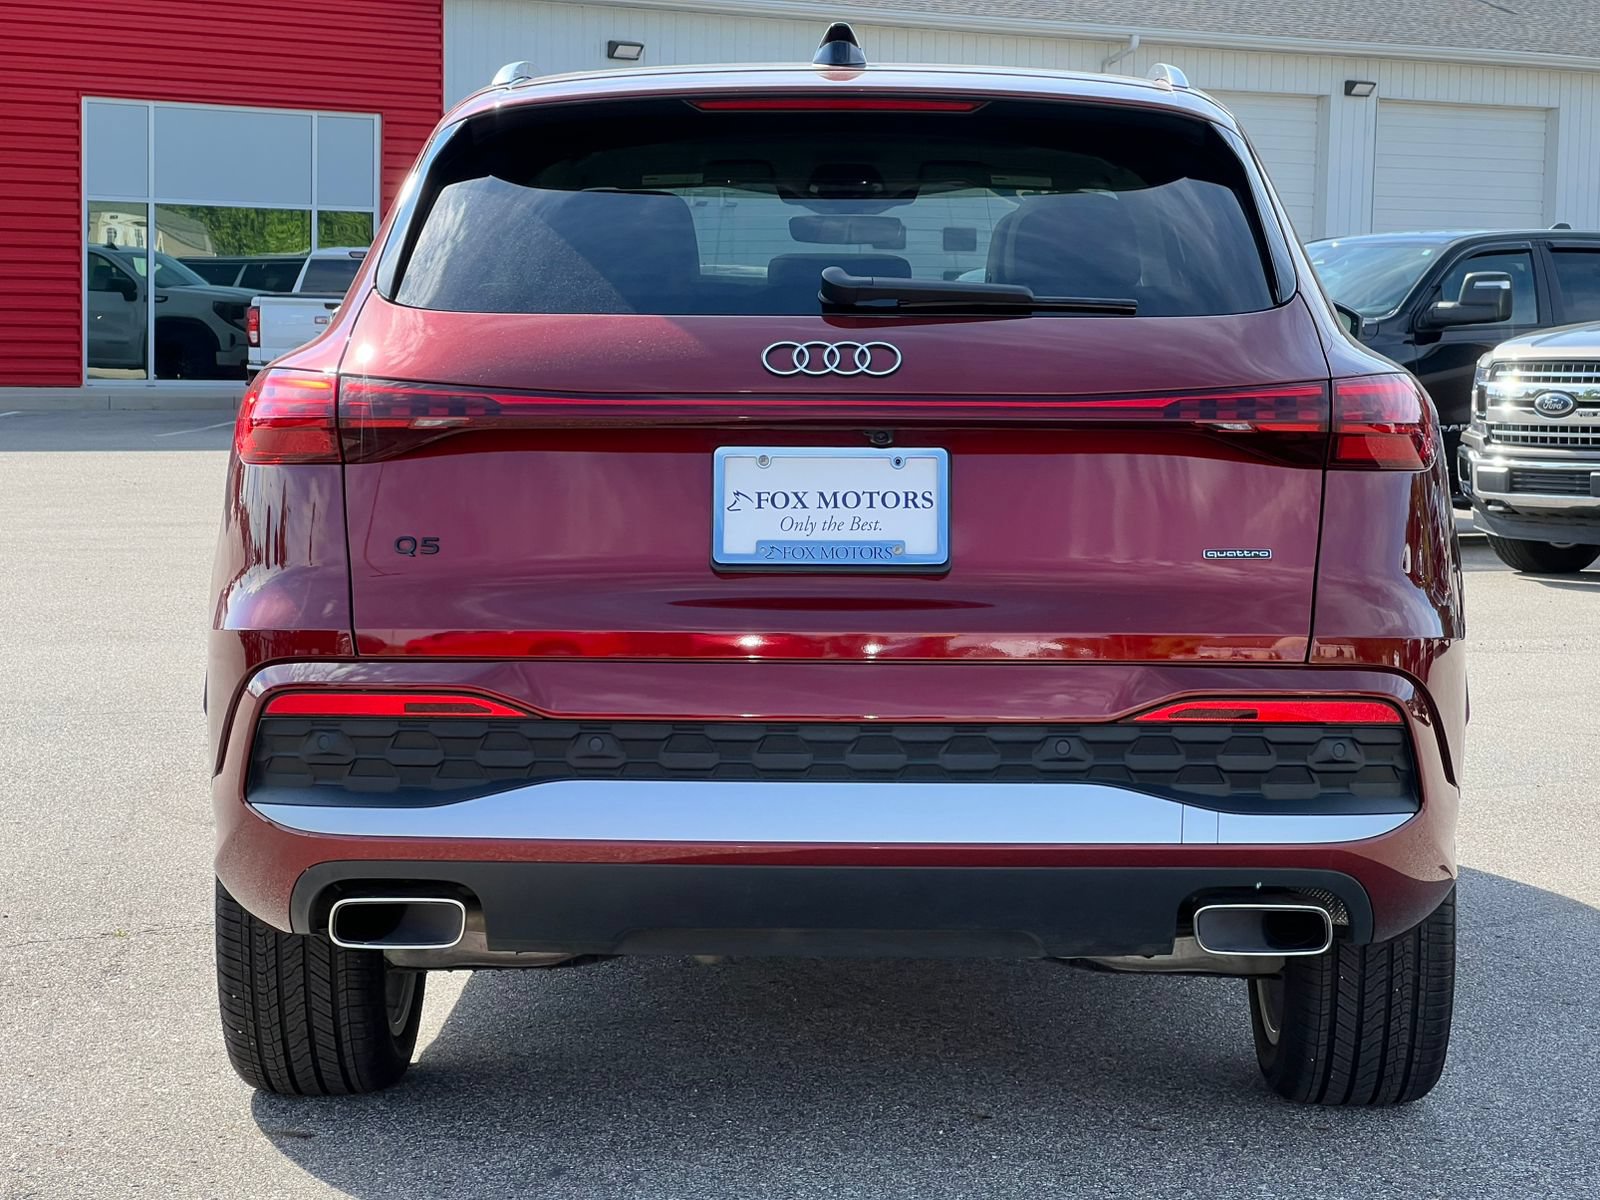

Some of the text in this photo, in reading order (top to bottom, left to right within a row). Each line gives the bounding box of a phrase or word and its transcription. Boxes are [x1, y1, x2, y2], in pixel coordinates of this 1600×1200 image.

[1542, 398, 1564, 410] Ford
[755, 491, 934, 509] FOX MOTORS
[780, 515, 883, 536] Only the Best.
[394, 535, 440, 557] Q5
[783, 546, 893, 560] FOX MOTORS
[1206, 550, 1269, 558] quattro
